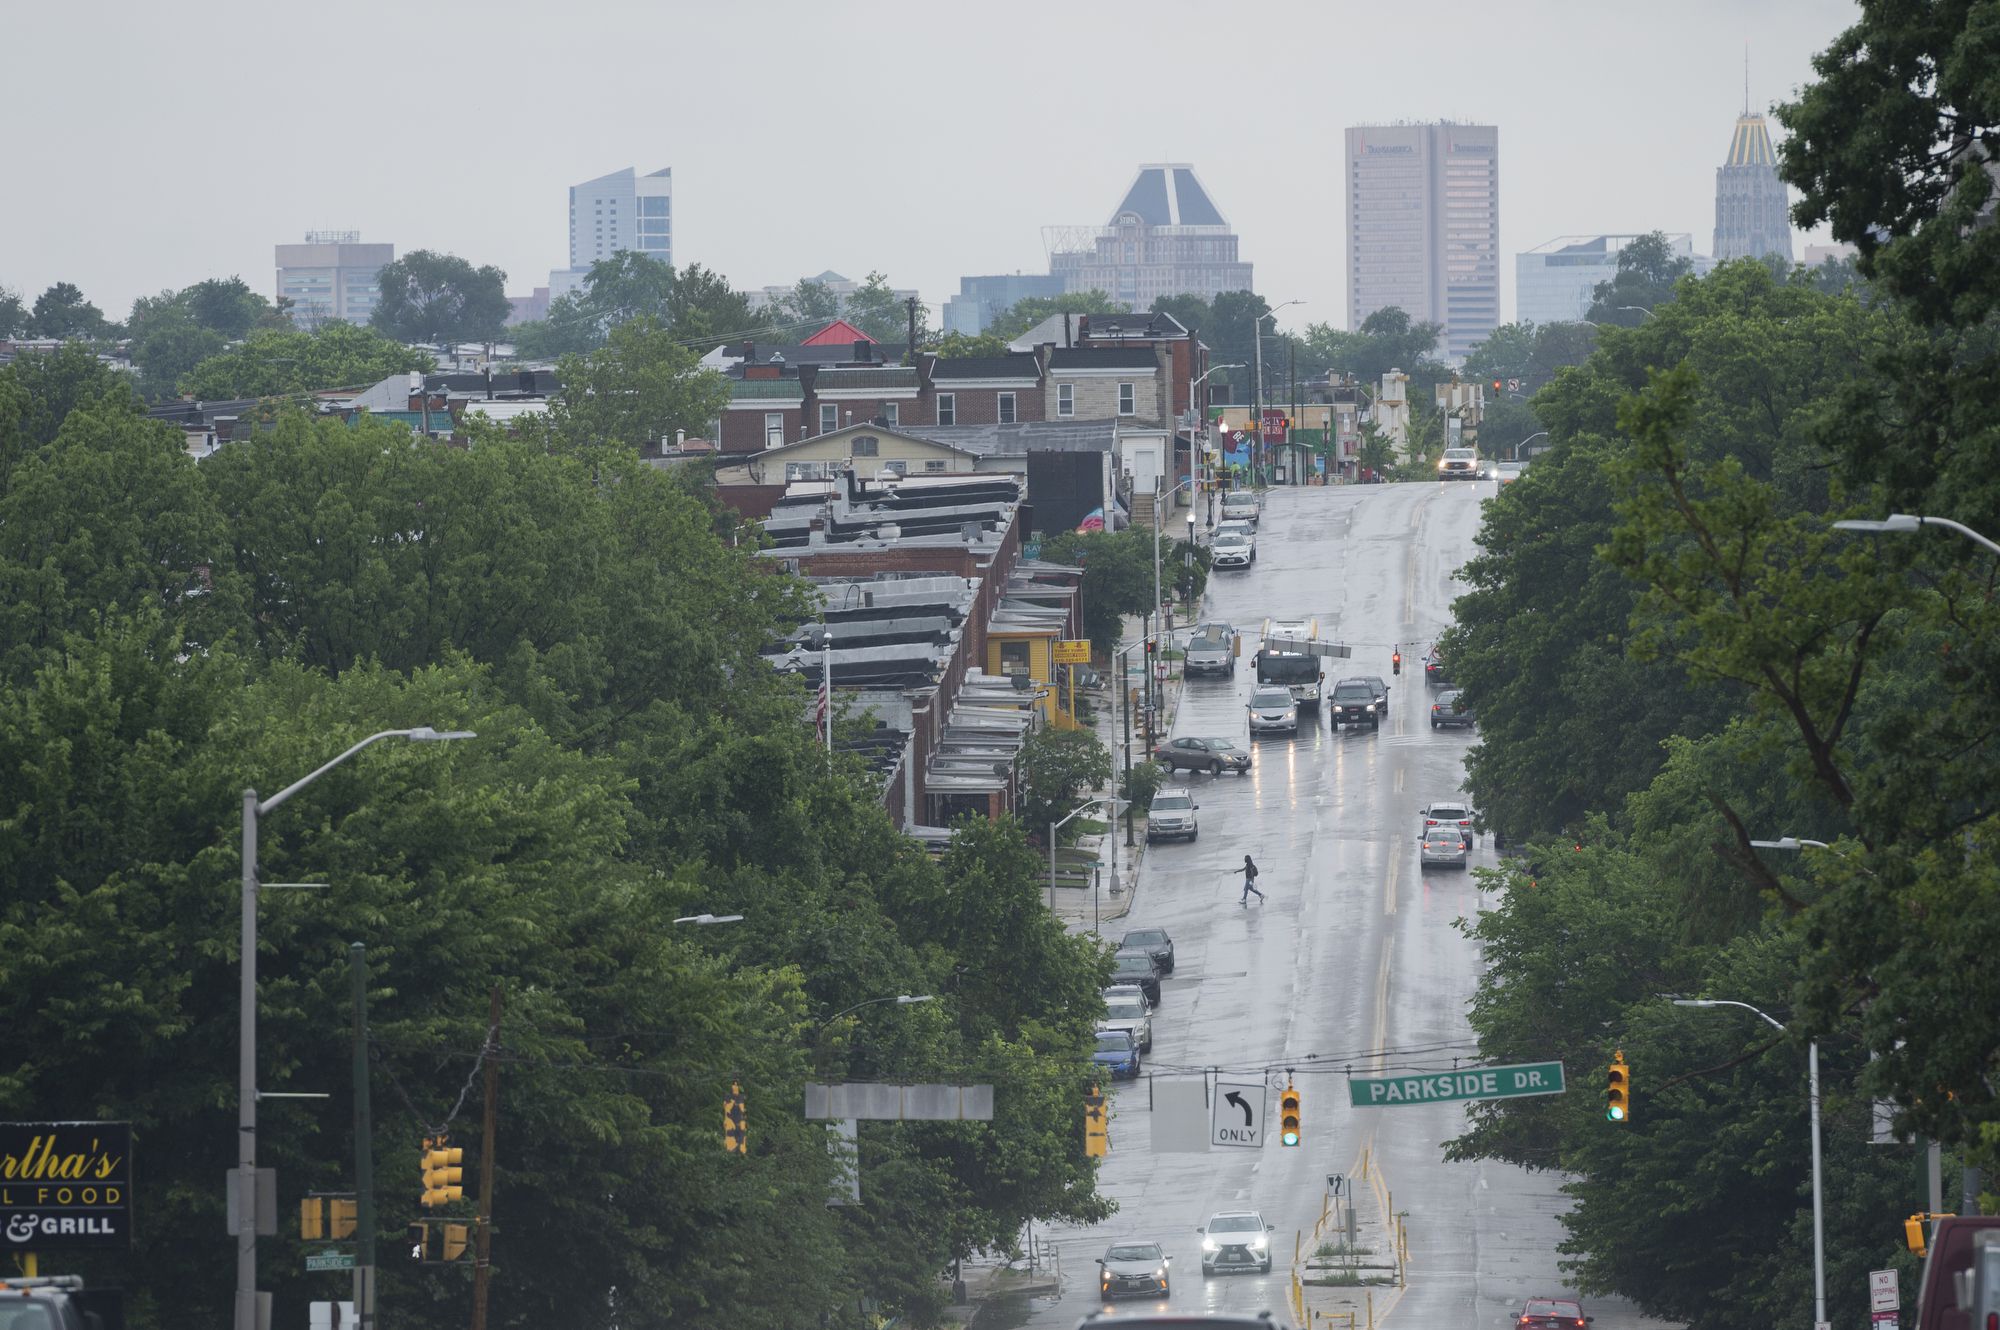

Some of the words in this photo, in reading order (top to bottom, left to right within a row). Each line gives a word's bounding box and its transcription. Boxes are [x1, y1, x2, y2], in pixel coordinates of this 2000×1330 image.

[1023, 544, 1041, 552] PLAY
[1370, 1073, 1498, 1101] PARKSIDE
[1514, 1071, 1549, 1088] DR.
[1220, 1128, 1256, 1142] ONLY
[38, 1187, 120, 1204] FOOD
[41, 1217, 115, 1234] GRILL
[1879, 1275, 1889, 1284] NO
[1872, 1286, 1896, 1297] STOPPING
